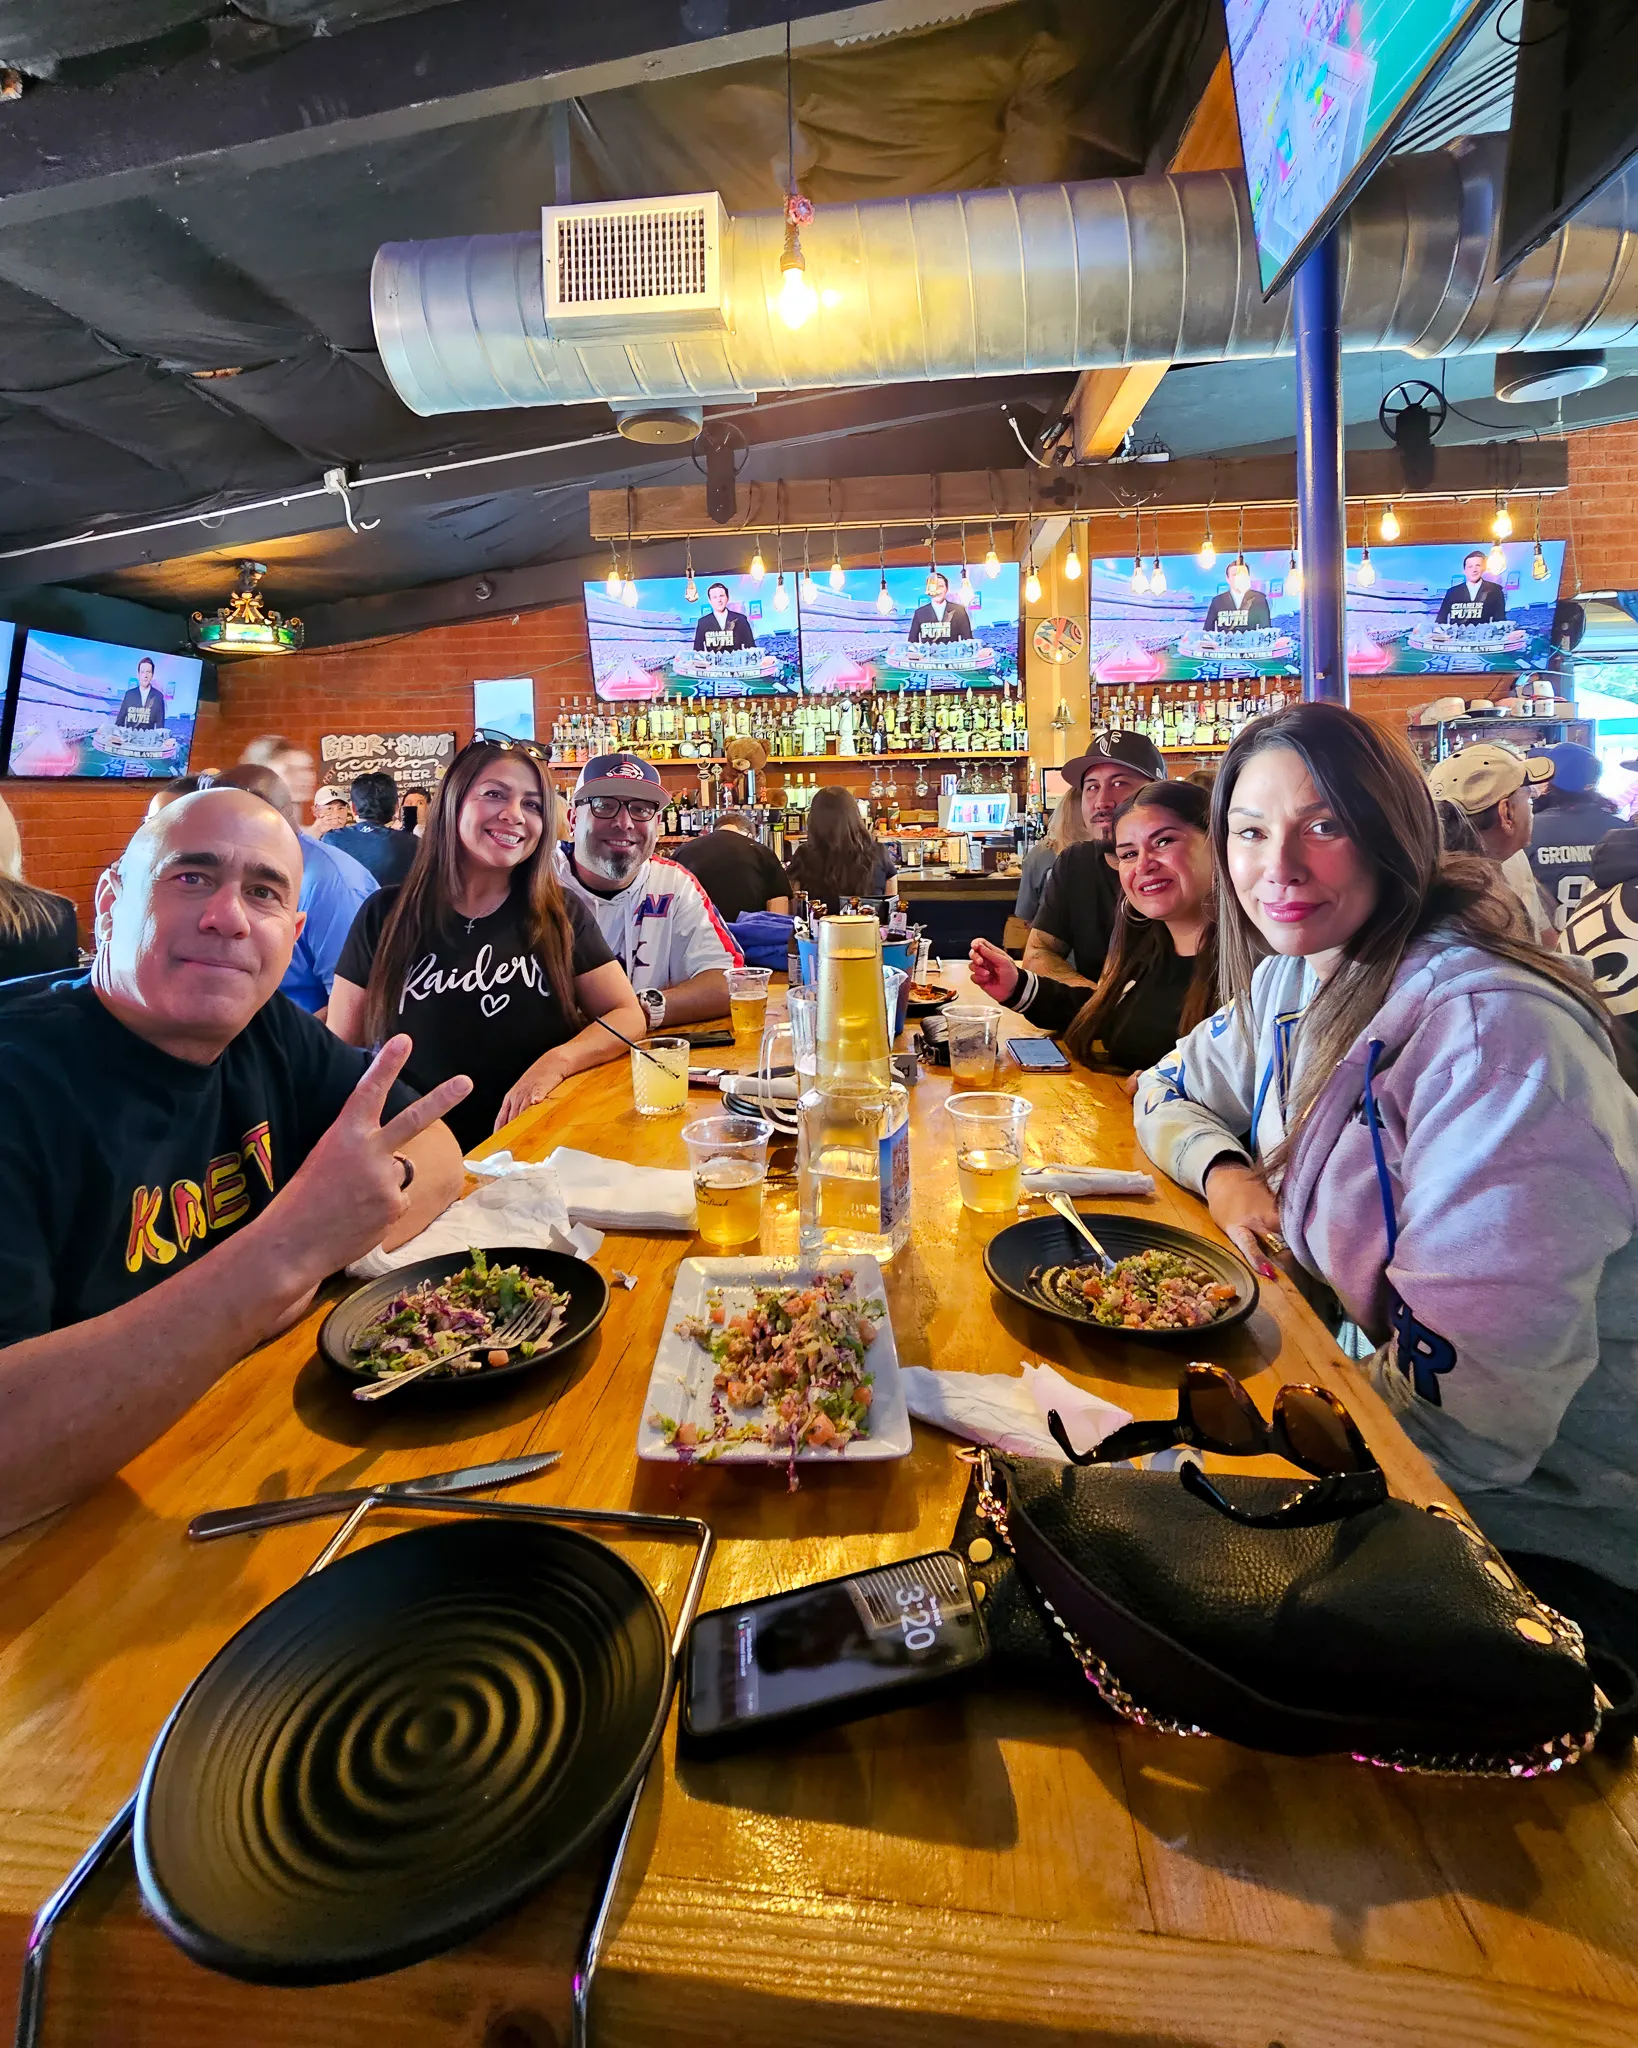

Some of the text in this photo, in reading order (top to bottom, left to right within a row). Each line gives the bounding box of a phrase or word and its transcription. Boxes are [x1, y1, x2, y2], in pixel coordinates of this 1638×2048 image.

[1450, 609, 1482, 619] PUTH
[1218, 615, 1249, 627] PUTH
[920, 628, 951, 638] PUTH
[705, 637, 734, 647] PUTH
[127, 712, 151, 724] PUTH
[393, 768, 432, 781] BEER
[896, 1582, 936, 1651] 3:20
